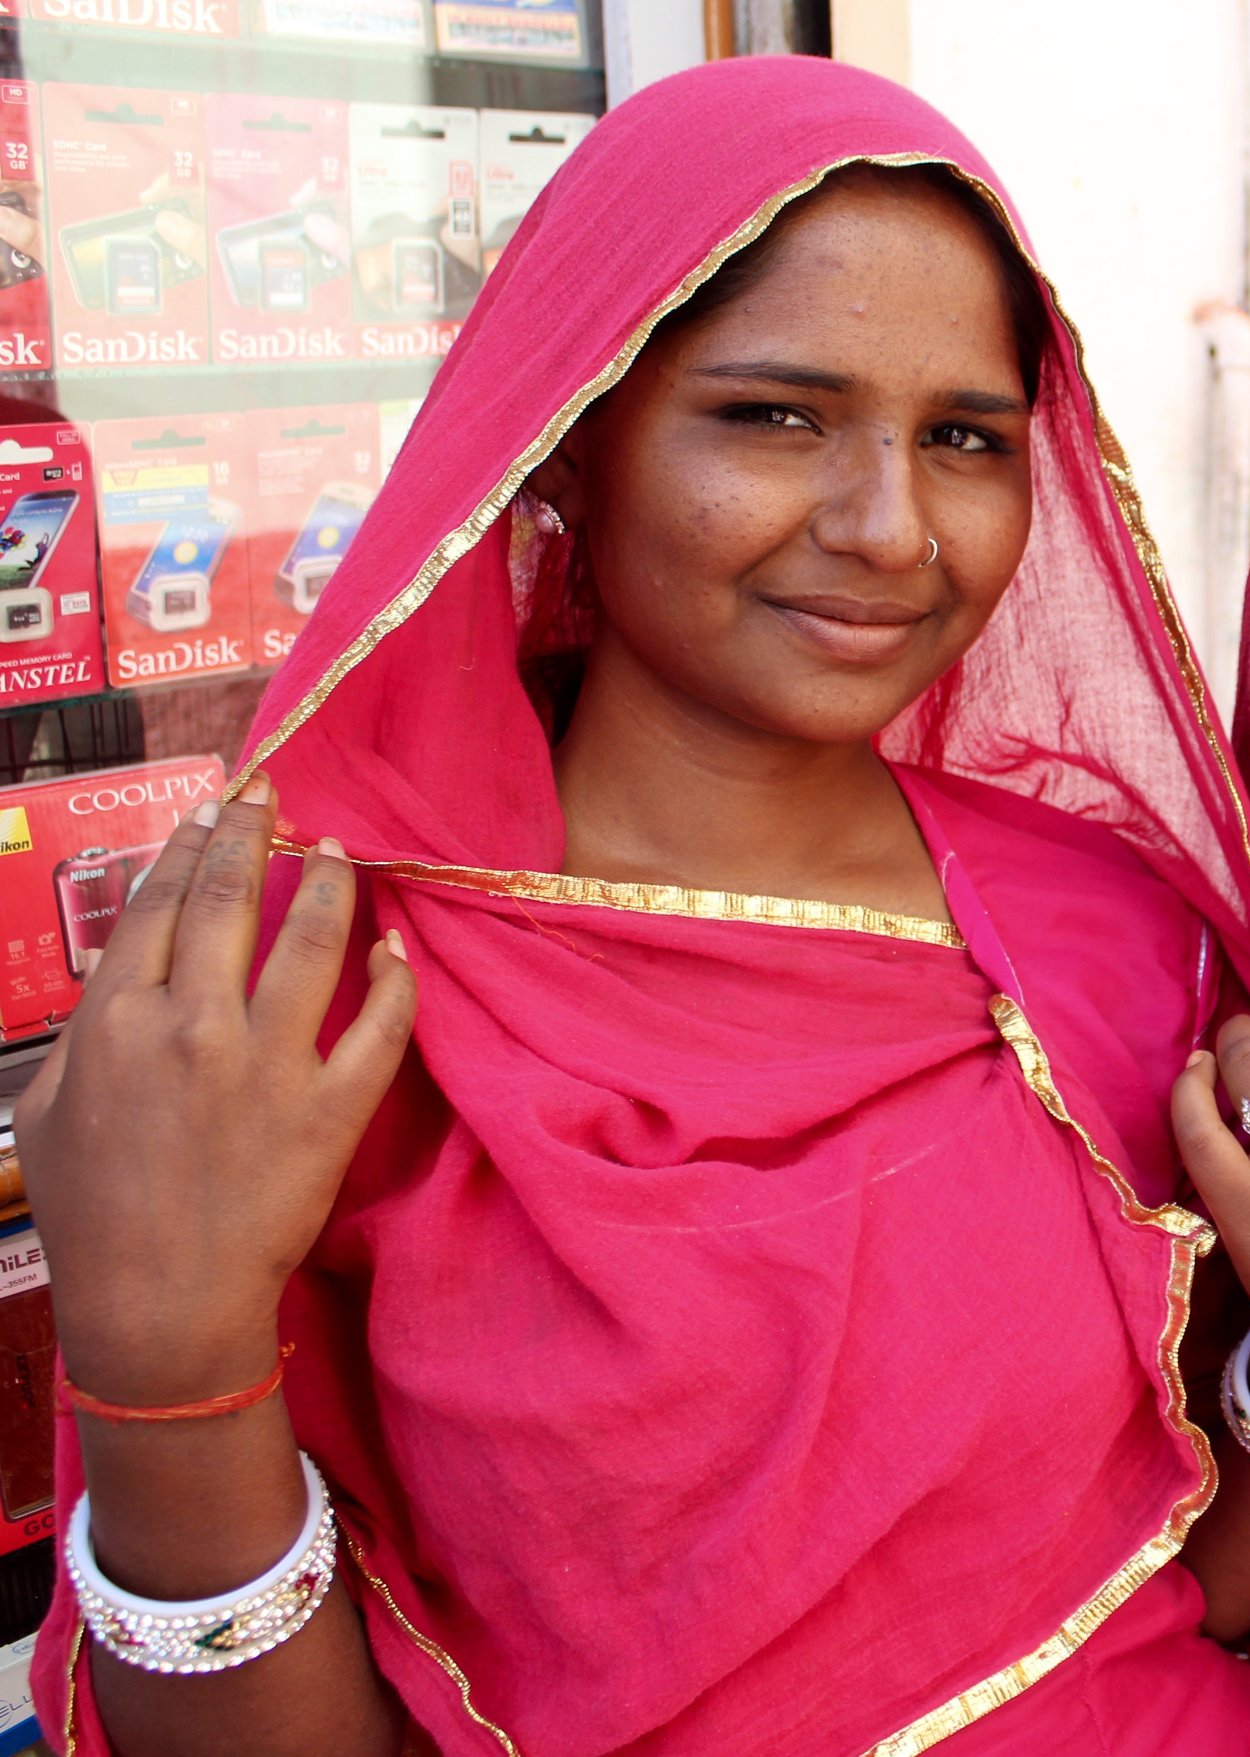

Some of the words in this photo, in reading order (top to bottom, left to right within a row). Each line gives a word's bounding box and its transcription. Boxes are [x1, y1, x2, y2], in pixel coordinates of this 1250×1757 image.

[5, 142, 29, 159] 32
[173, 150, 193, 168] 32
[9, 161, 28, 170] GB
[63, 331, 201, 364] SanDisk
[218, 327, 346, 361] SanDisk
[19, 656, 52, 667] MEMORY
[52, 652, 73, 663] CARD
[118, 637, 242, 680] SanDisk
[68, 769, 216, 816] COOLPIX
[70, 867, 106, 883] Nikon
[73, 906, 118, 922] COOLPIX
